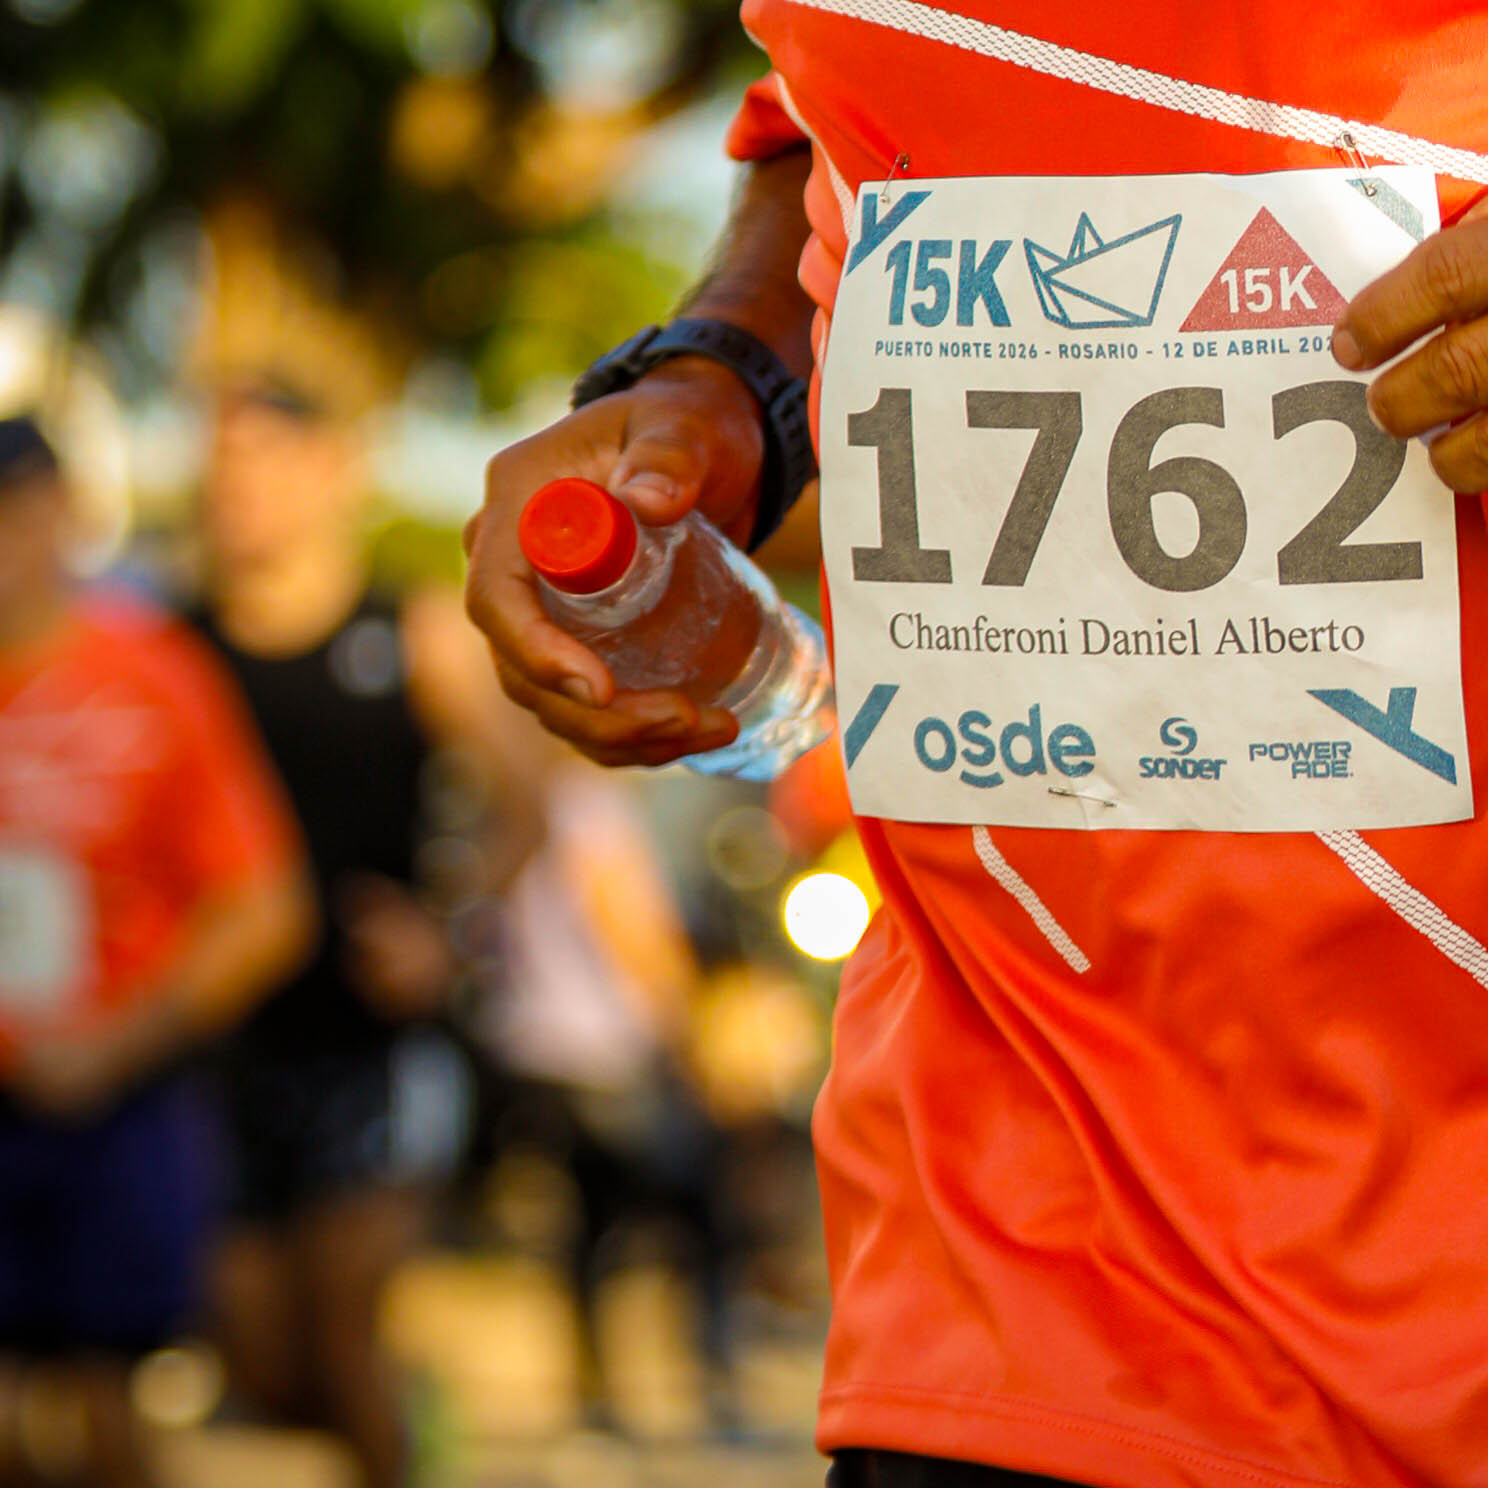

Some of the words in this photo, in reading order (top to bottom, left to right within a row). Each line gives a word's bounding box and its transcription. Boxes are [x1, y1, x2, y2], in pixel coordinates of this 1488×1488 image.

[885, 239, 1013, 327] 15K
[1219, 264, 1319, 314] 15K
[875, 340, 933, 357] PUERTO
[939, 341, 992, 358] NORTE
[998, 343, 1038, 360] 2026
[1058, 343, 1138, 360] ROSARIO
[1162, 342, 1184, 358] 12
[1193, 340, 1218, 357] DE
[1227, 338, 1290, 356] ABRIL
[846, 380, 1424, 592] 1762
[889, 612, 1067, 655] Chanferoni
[1081, 617, 1200, 656] Daniel
[1217, 617, 1365, 655] Alberto
[913, 703, 1096, 779] osde
[1249, 741, 1352, 761] POWER
